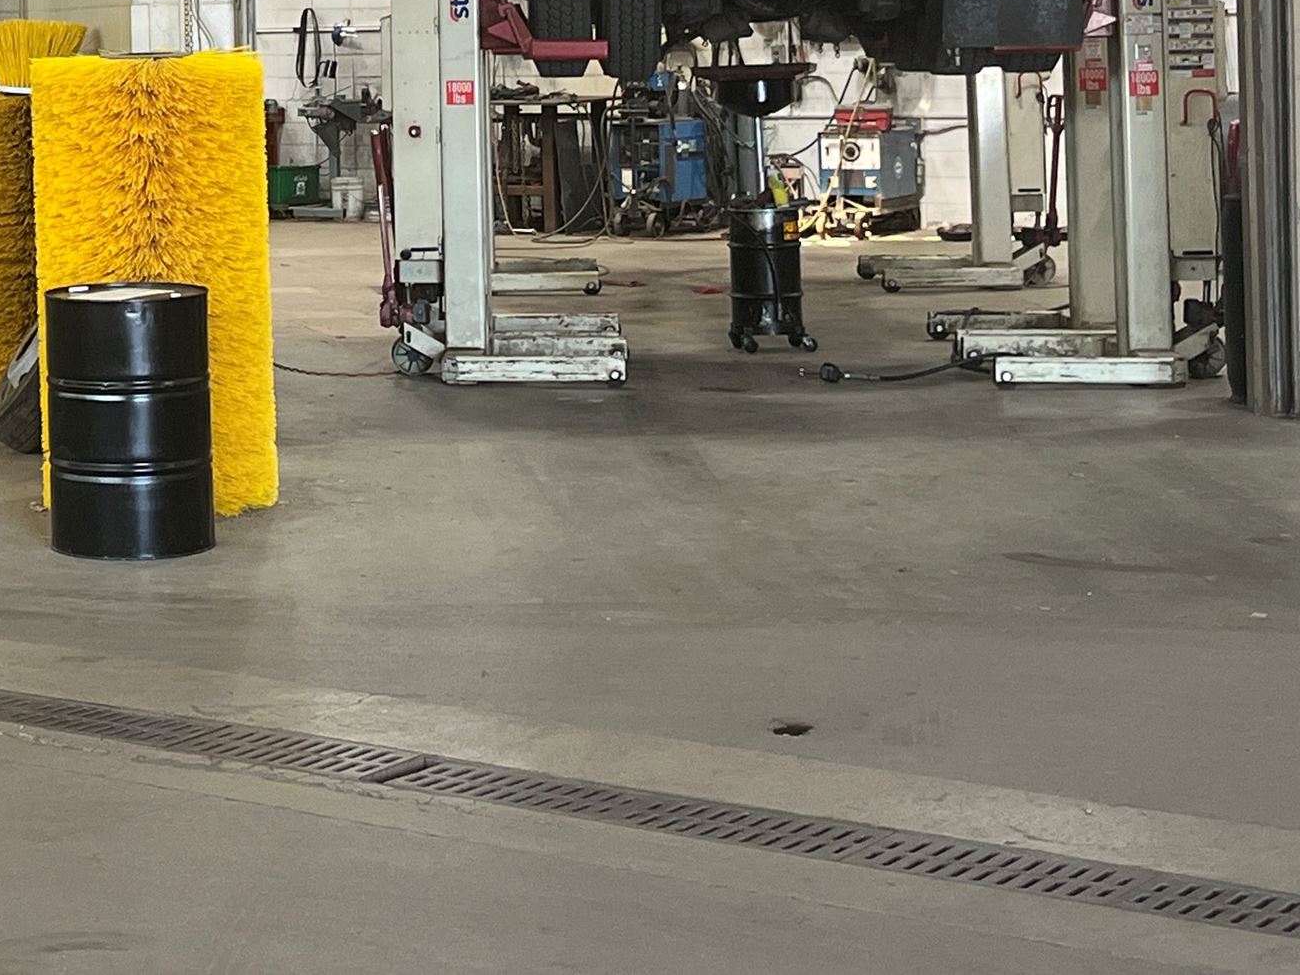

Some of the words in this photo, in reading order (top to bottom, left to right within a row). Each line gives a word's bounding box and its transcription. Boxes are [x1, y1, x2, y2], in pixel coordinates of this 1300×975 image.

[447, 81, 472, 93] 18000
[1137, 84, 1151, 95] lbs
[453, 93, 466, 103] lbs
